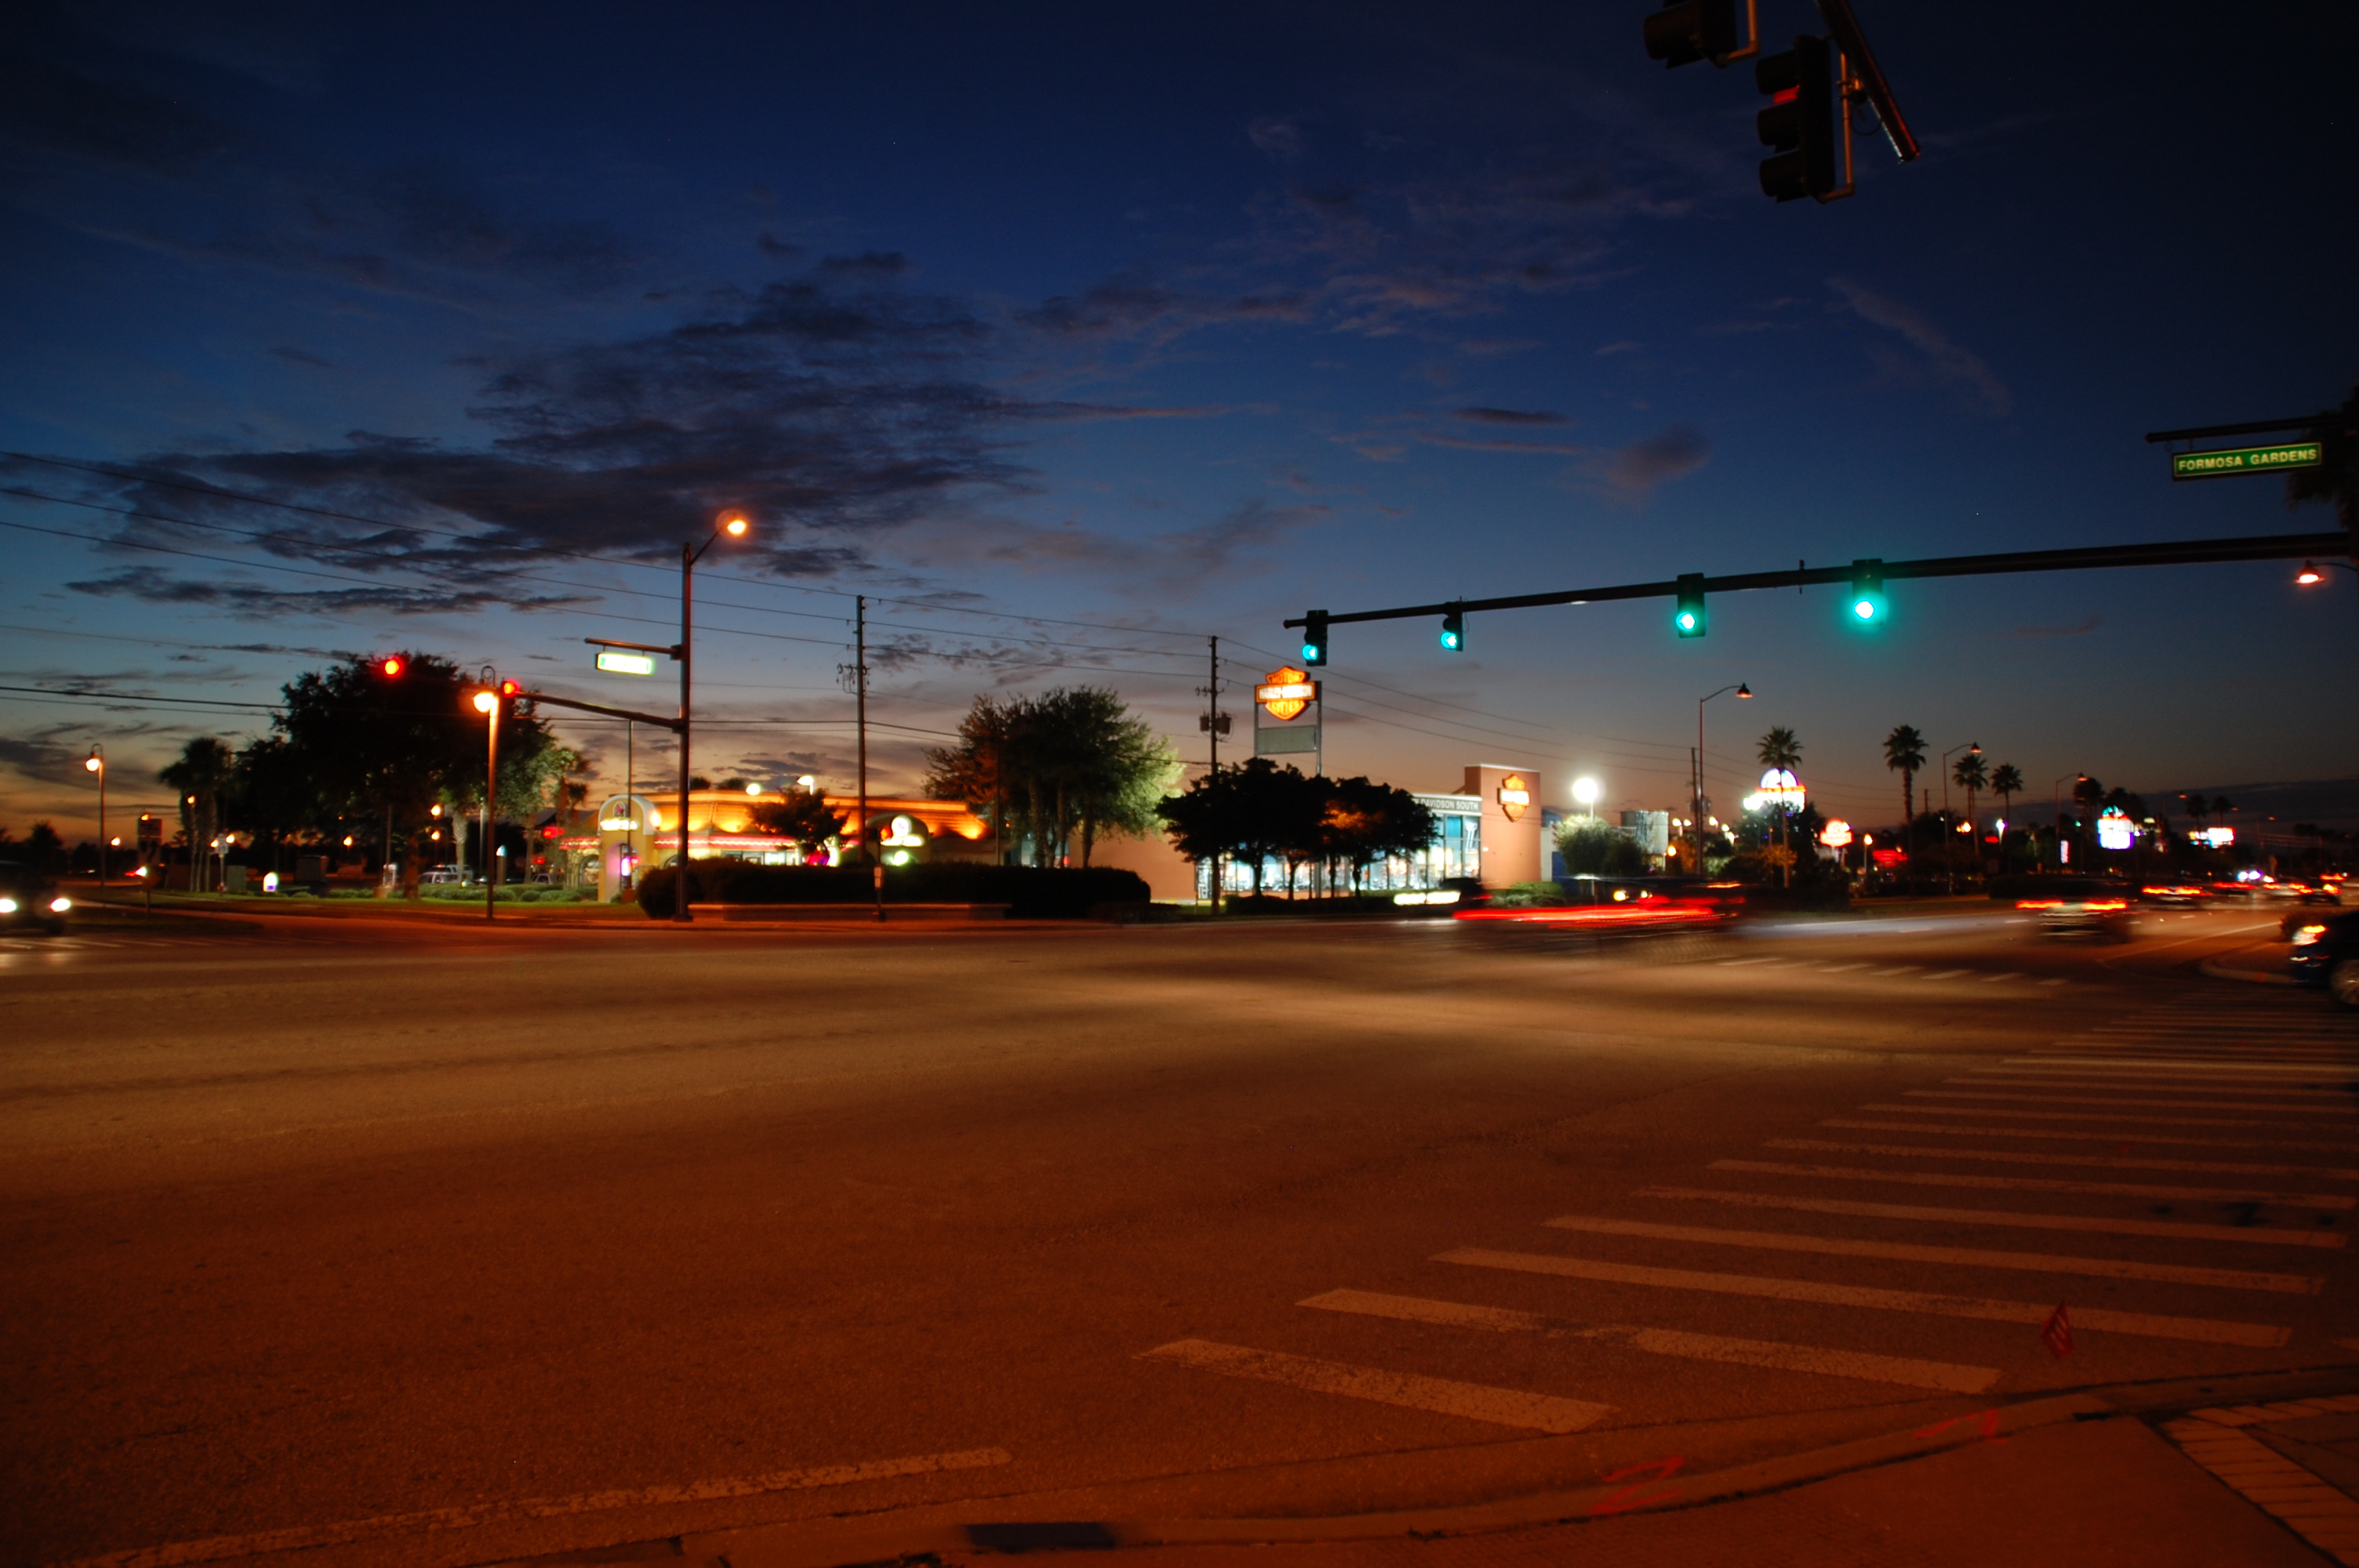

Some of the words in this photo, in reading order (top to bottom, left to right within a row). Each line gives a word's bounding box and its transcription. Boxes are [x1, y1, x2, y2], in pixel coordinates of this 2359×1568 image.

[2179, 456, 2244, 470] FORMOSA
[2250, 448, 2317, 465] GARDENS
[1456, 800, 1479, 811] SOUTH
